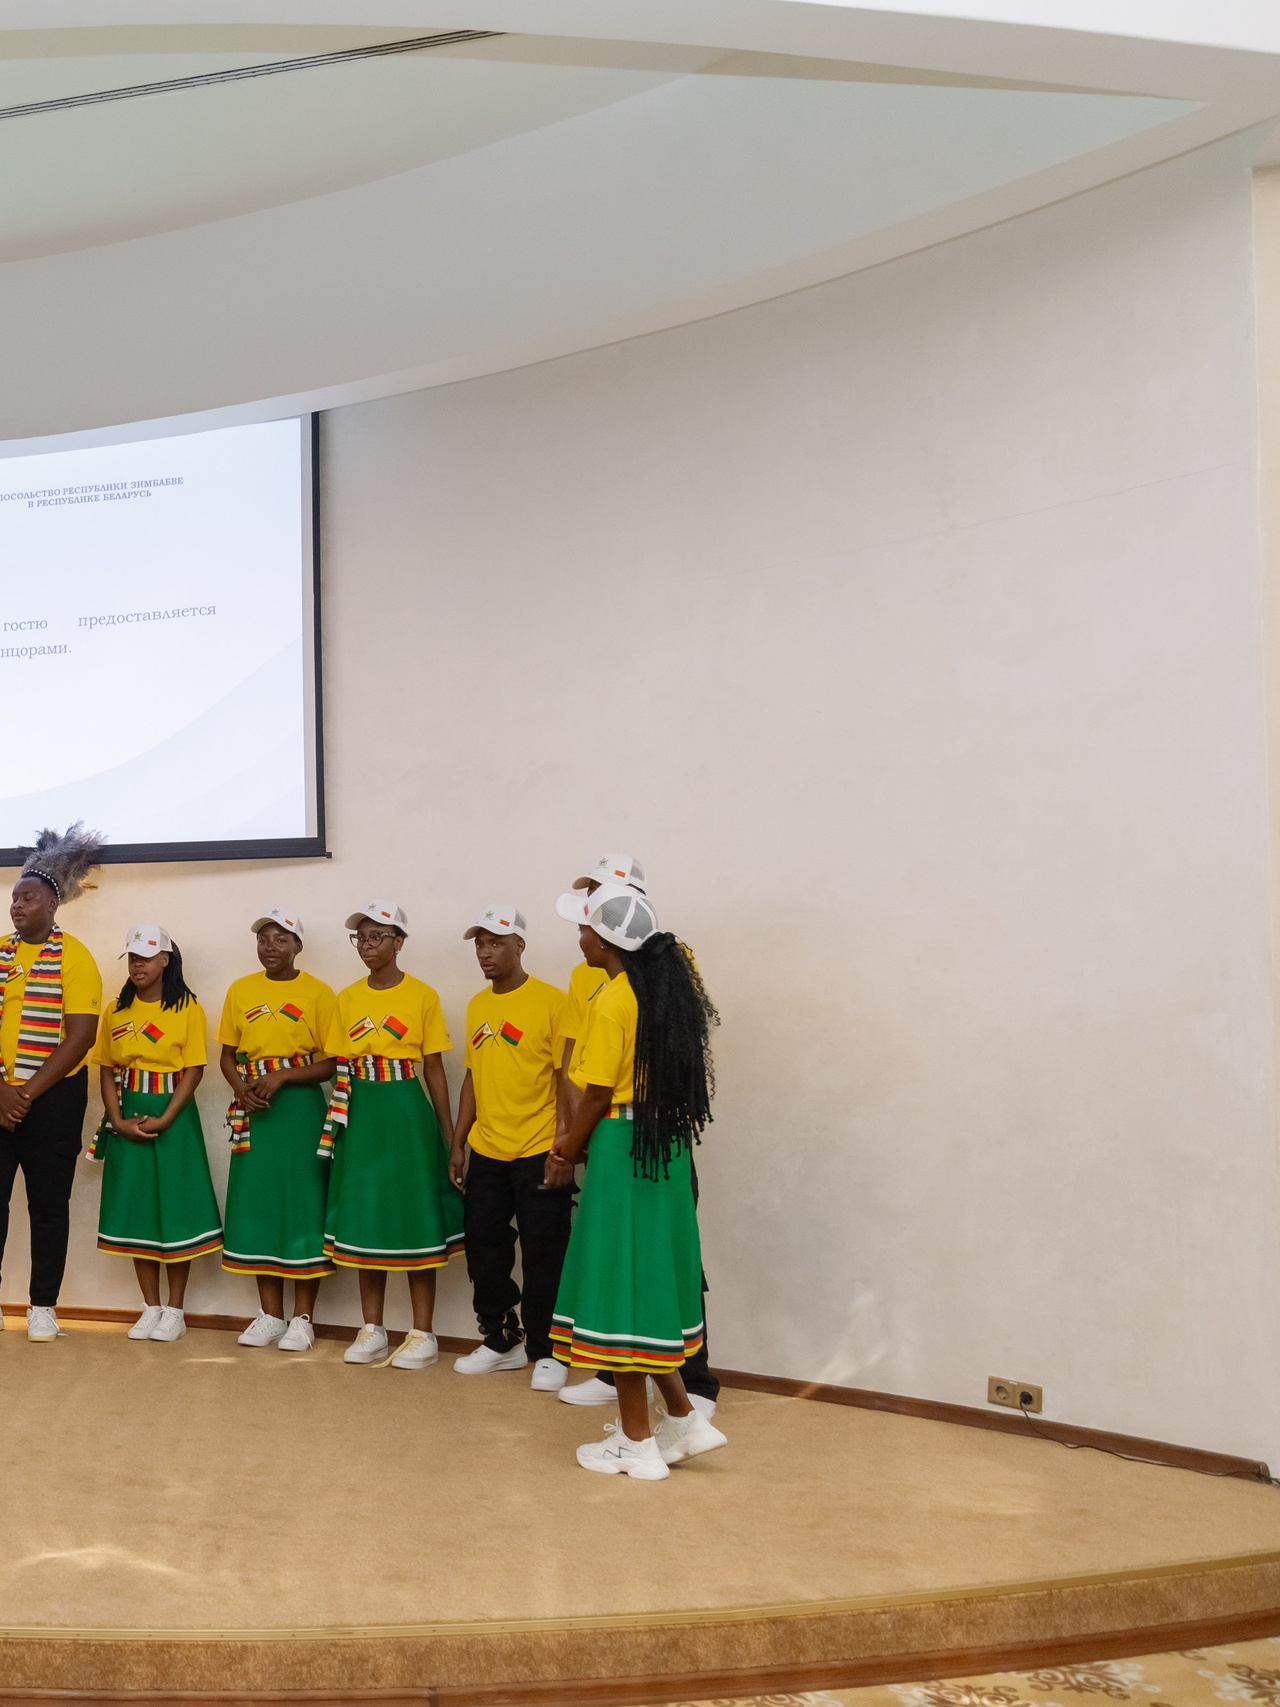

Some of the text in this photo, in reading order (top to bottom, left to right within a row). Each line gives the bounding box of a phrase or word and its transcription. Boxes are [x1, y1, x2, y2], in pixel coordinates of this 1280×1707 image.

[63, 483, 127, 495] РЕСПУБЛИКИ
[130, 477, 183, 488] ЗИМБАБВЕ
[37, 495, 100, 507] РЕСПУБЛИКЕ
[103, 490, 151, 500] БЕЛАРУСЬ
[3, 619, 47, 632] гостю
[78, 605, 216, 629] предоставляется
